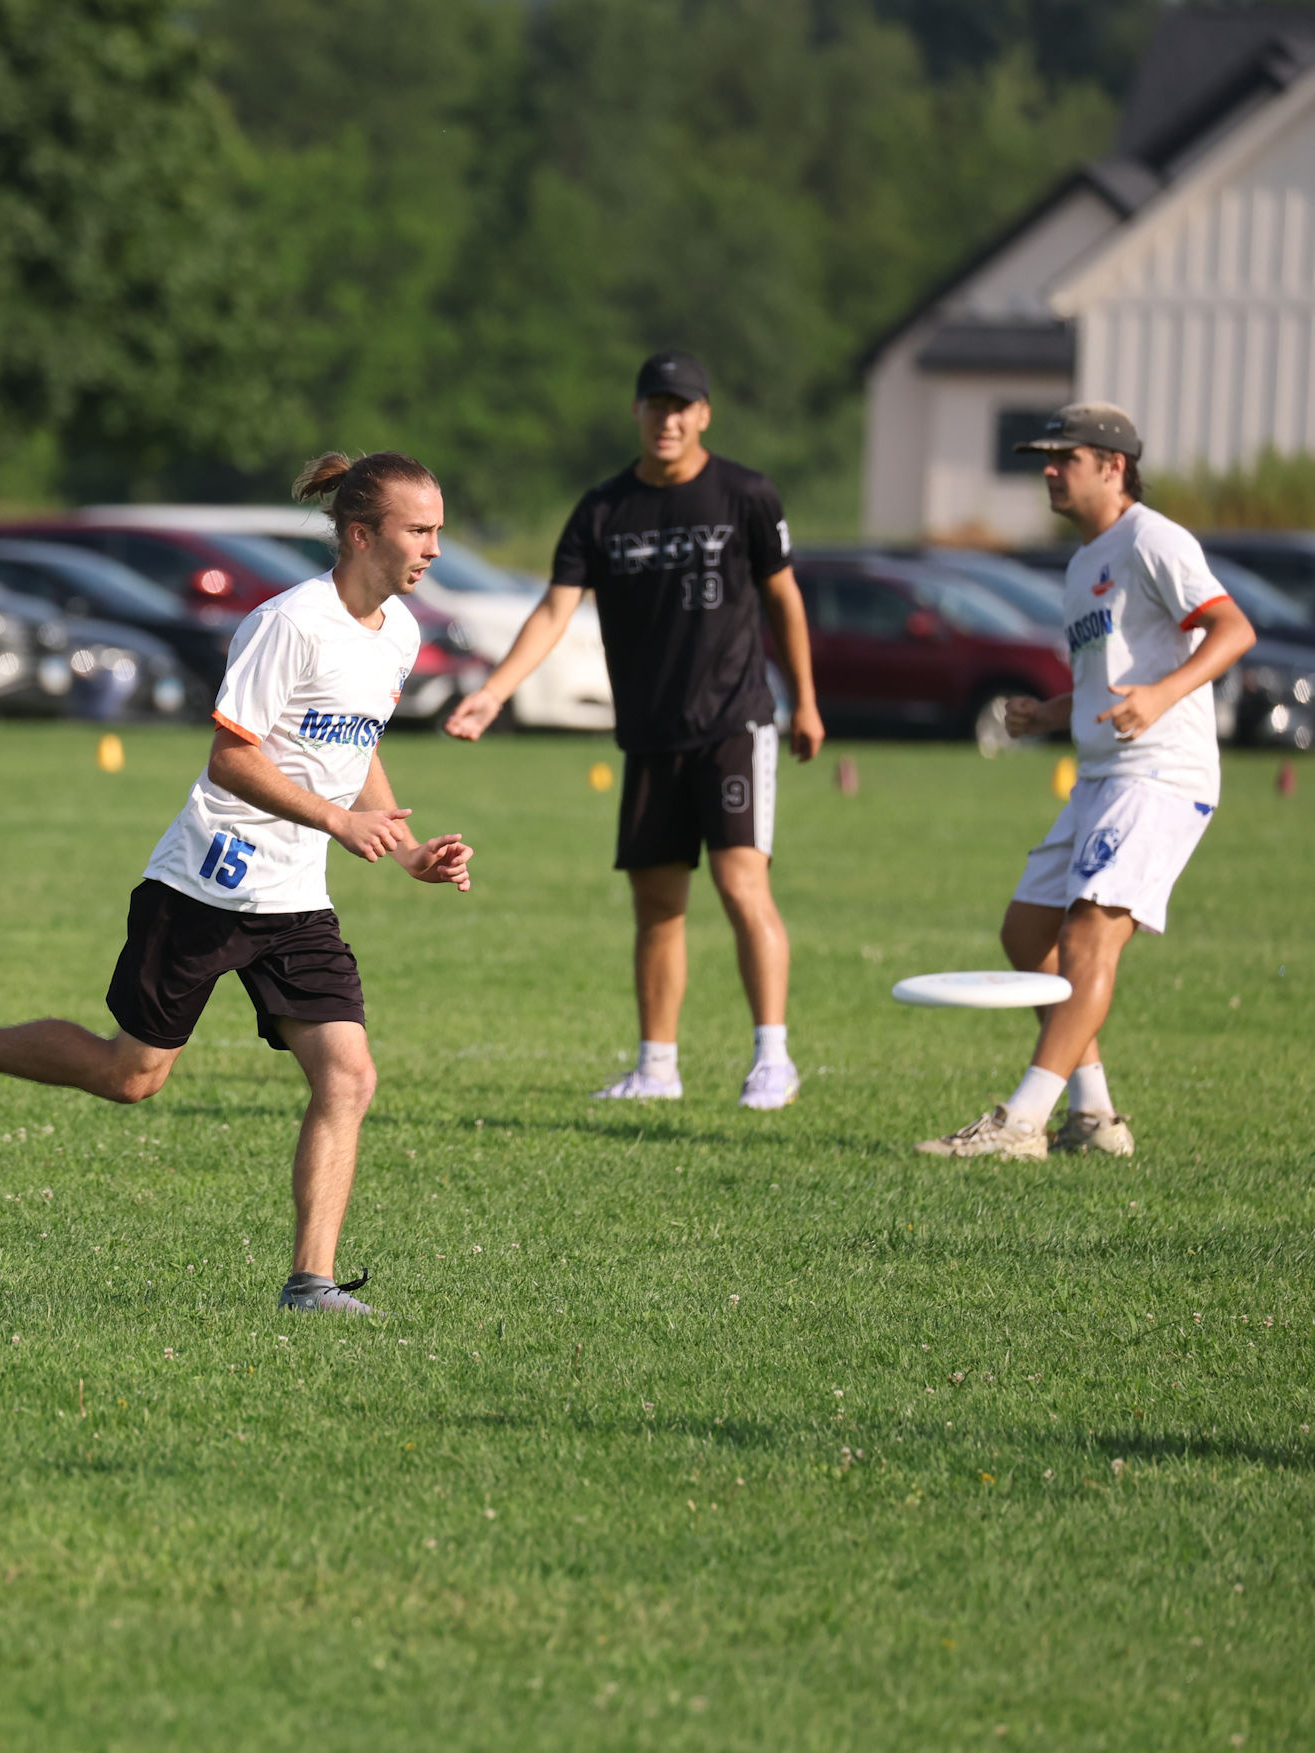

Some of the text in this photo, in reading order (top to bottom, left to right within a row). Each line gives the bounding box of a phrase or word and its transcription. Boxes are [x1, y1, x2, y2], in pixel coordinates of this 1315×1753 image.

[606, 525, 734, 574] INDY
[721, 775, 750, 813] 9
[199, 832, 256, 889] 15
